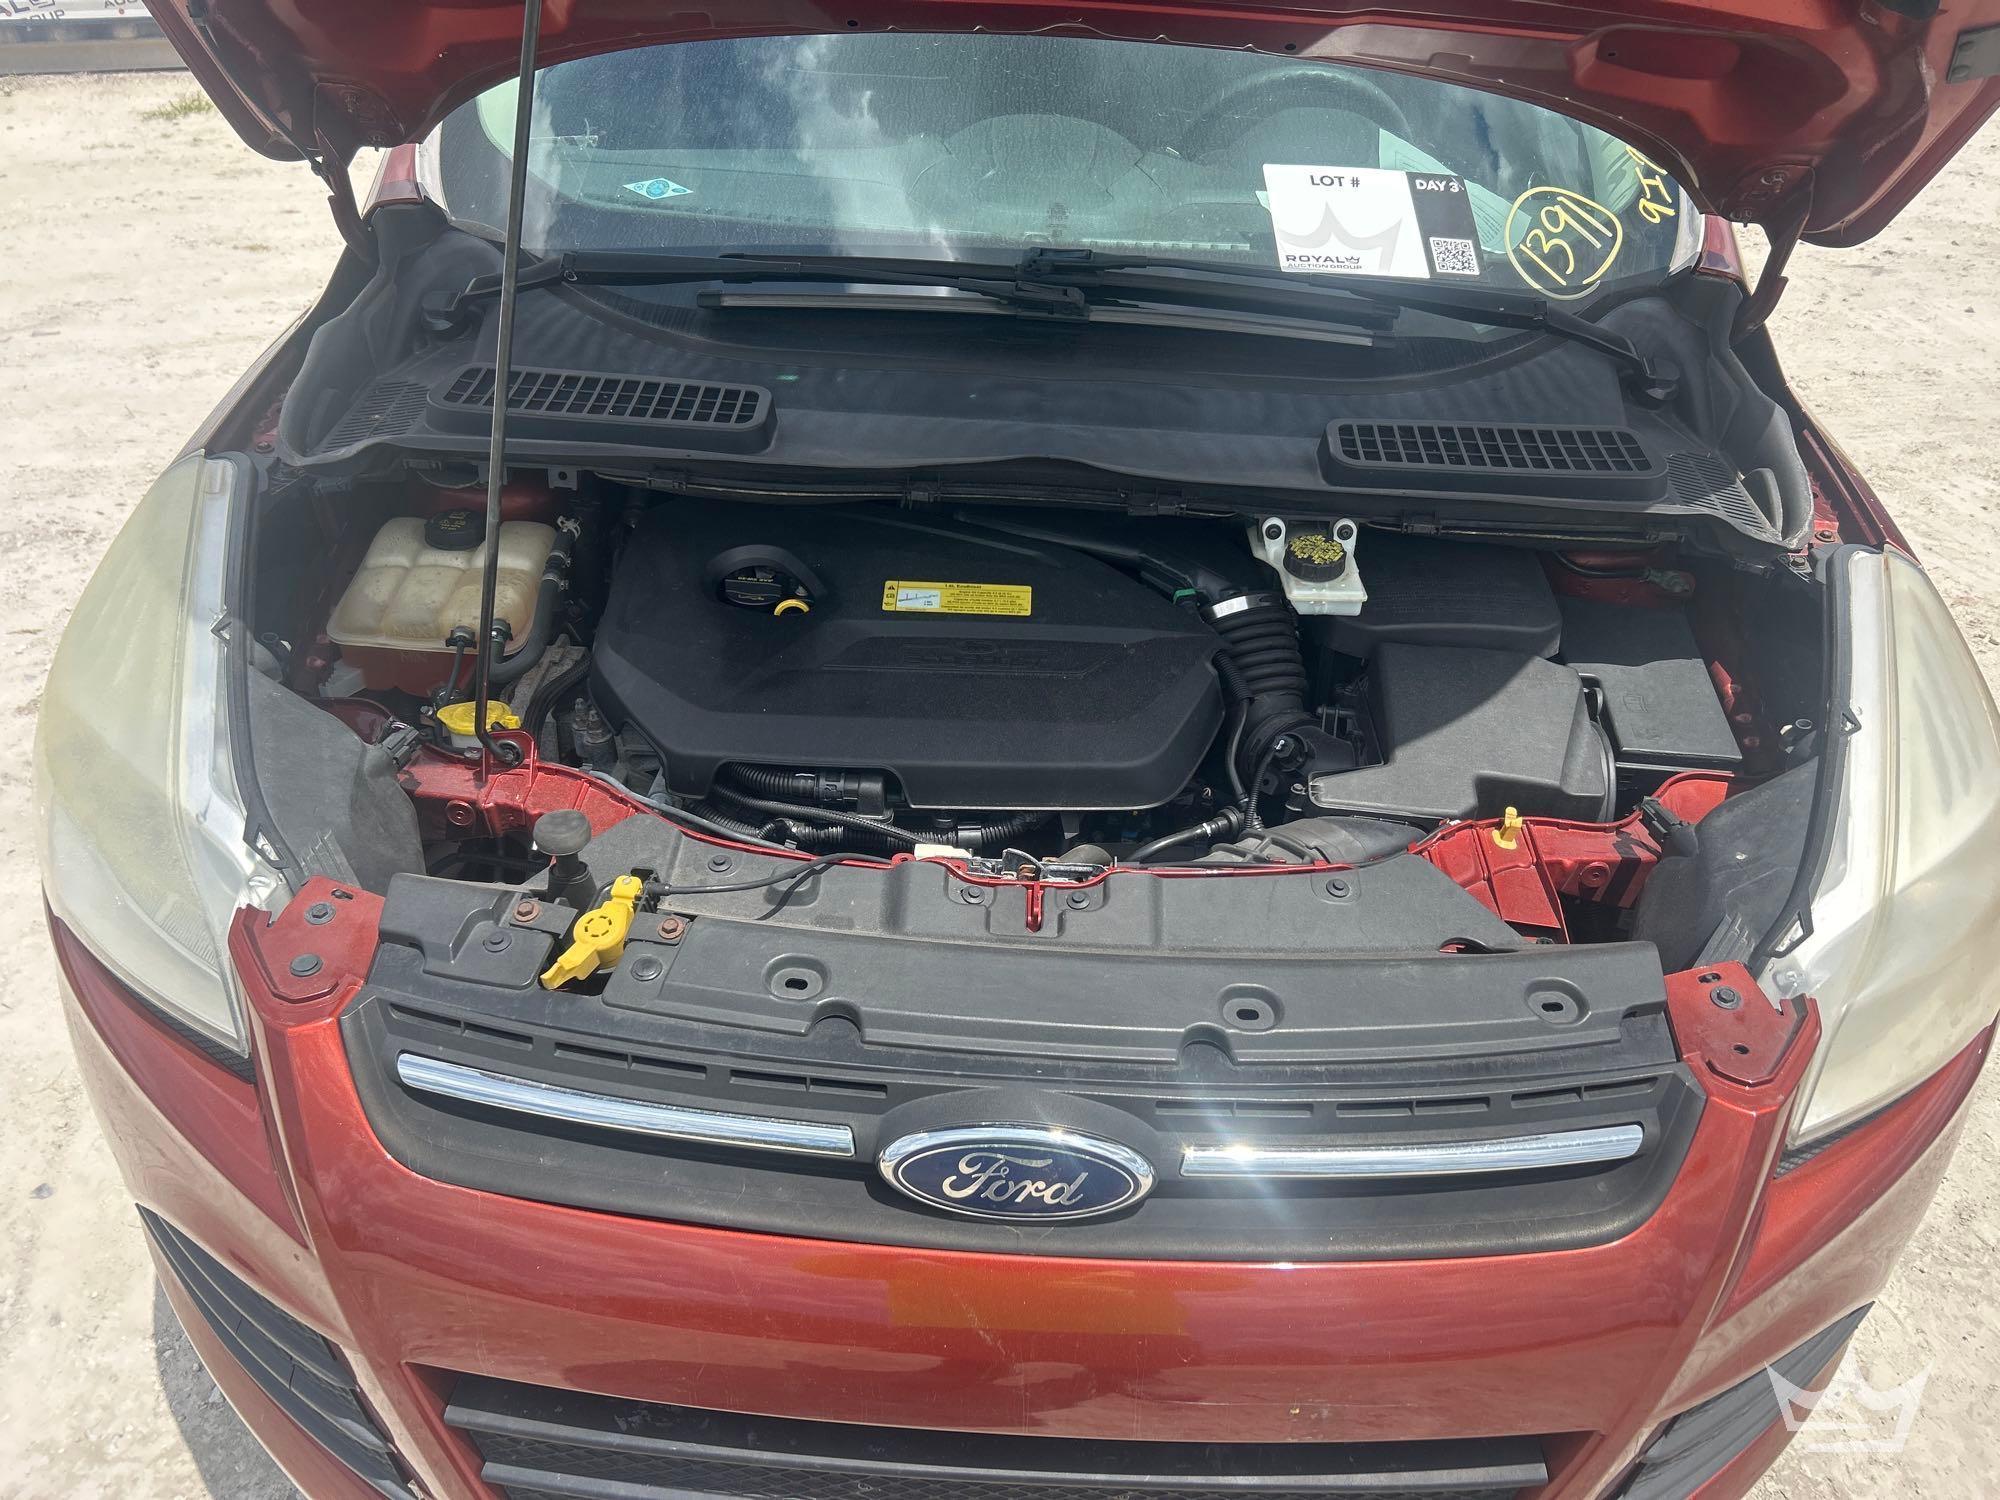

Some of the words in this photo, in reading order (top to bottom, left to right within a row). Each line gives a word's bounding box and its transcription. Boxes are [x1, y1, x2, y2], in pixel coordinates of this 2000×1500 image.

[1309, 174, 1345, 188] LOT
[1350, 176, 1361, 188] #
[1414, 179, 1446, 192] DAY
[1519, 196, 1614, 286] 1391
[1285, 254, 1346, 264] ROYAL
[942, 1151, 1089, 1206] Ford
